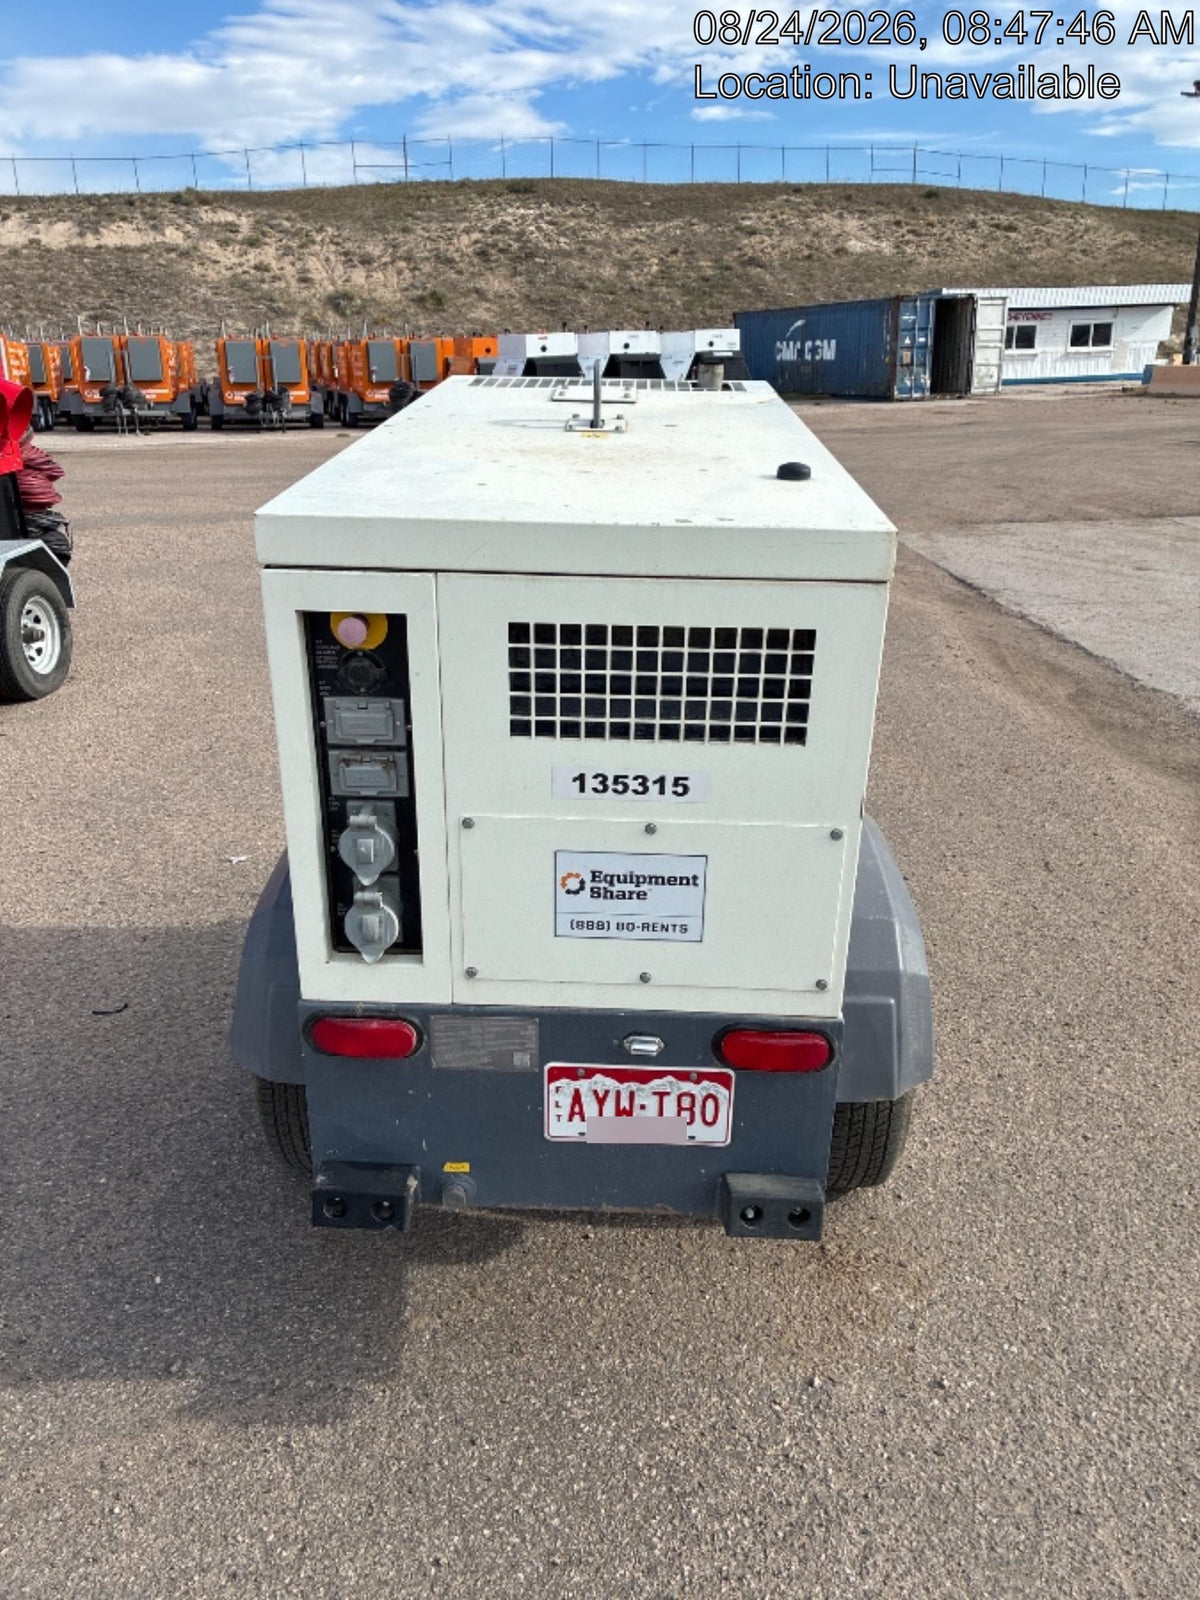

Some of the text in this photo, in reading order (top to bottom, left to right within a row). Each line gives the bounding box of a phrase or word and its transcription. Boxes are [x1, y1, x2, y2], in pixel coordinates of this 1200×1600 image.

[571, 773, 691, 797] 135315
[589, 870, 700, 887] Equipment
[589, 886, 648, 901] Share
[570, 919, 611, 932] (888)
